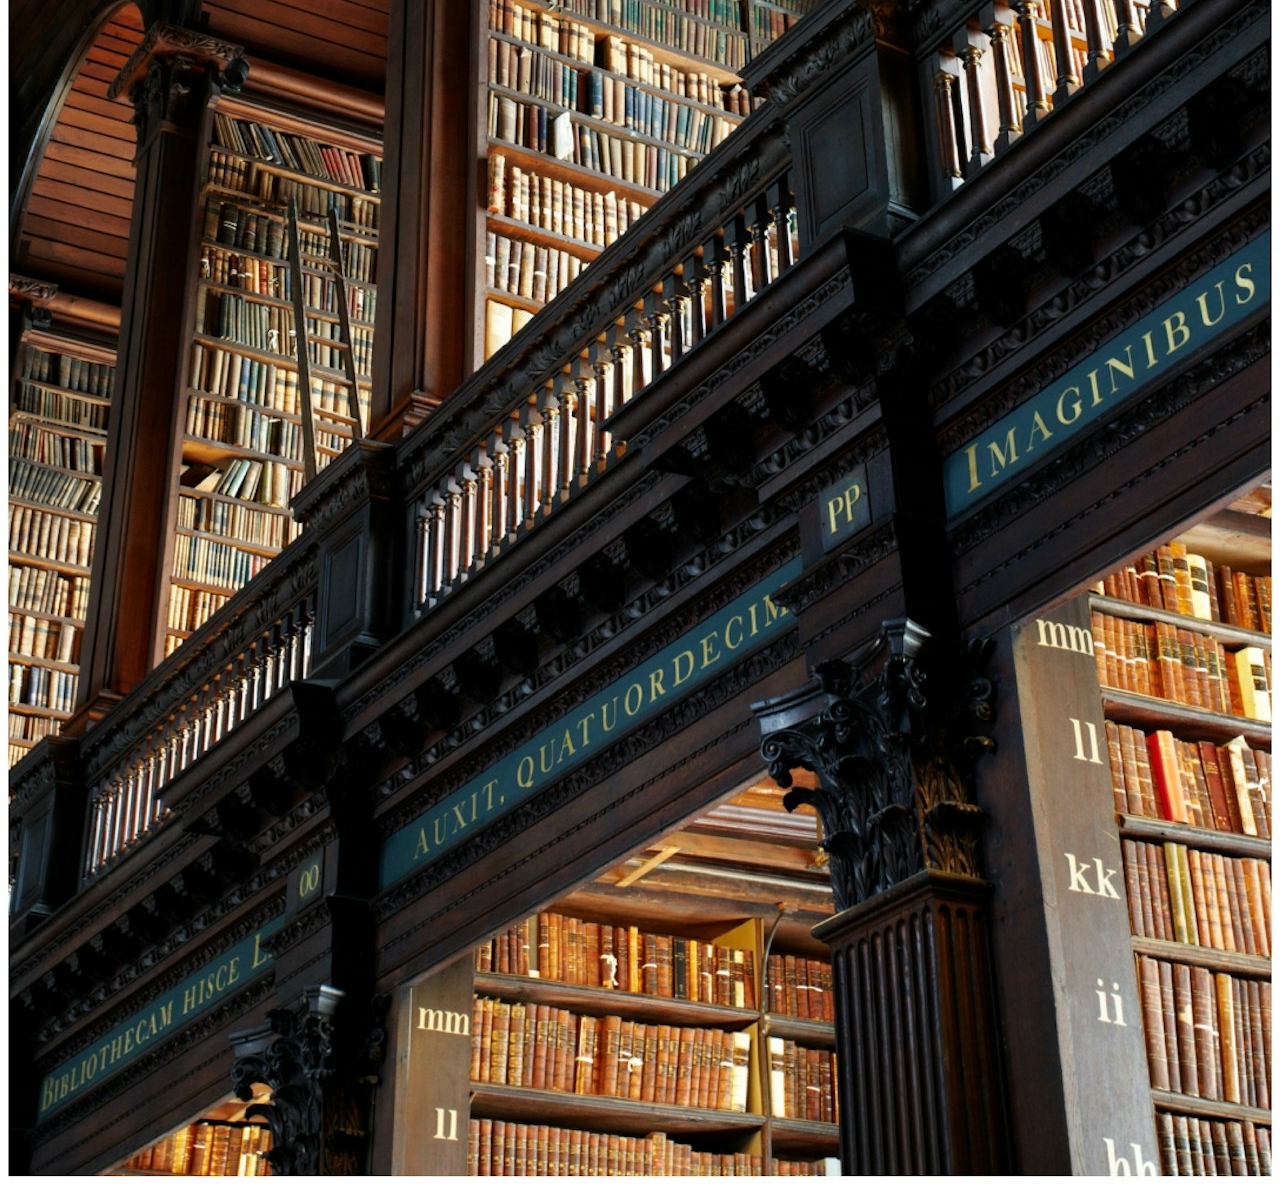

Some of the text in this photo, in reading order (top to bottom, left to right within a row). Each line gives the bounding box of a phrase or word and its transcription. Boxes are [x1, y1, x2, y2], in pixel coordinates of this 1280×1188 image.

[966, 261, 1257, 494] IMAGINIBUS
[827, 483, 861, 534] PP
[1035, 618, 1095, 657] mm
[412, 778, 506, 860] AUXIT,
[1064, 853, 1121, 900] kk
[417, 1006, 471, 1036] mm
[1095, 978, 1128, 1027] ii
[40, 999, 173, 1111] BIBLIOTHECAM
[183, 956, 240, 1014] HISCE
